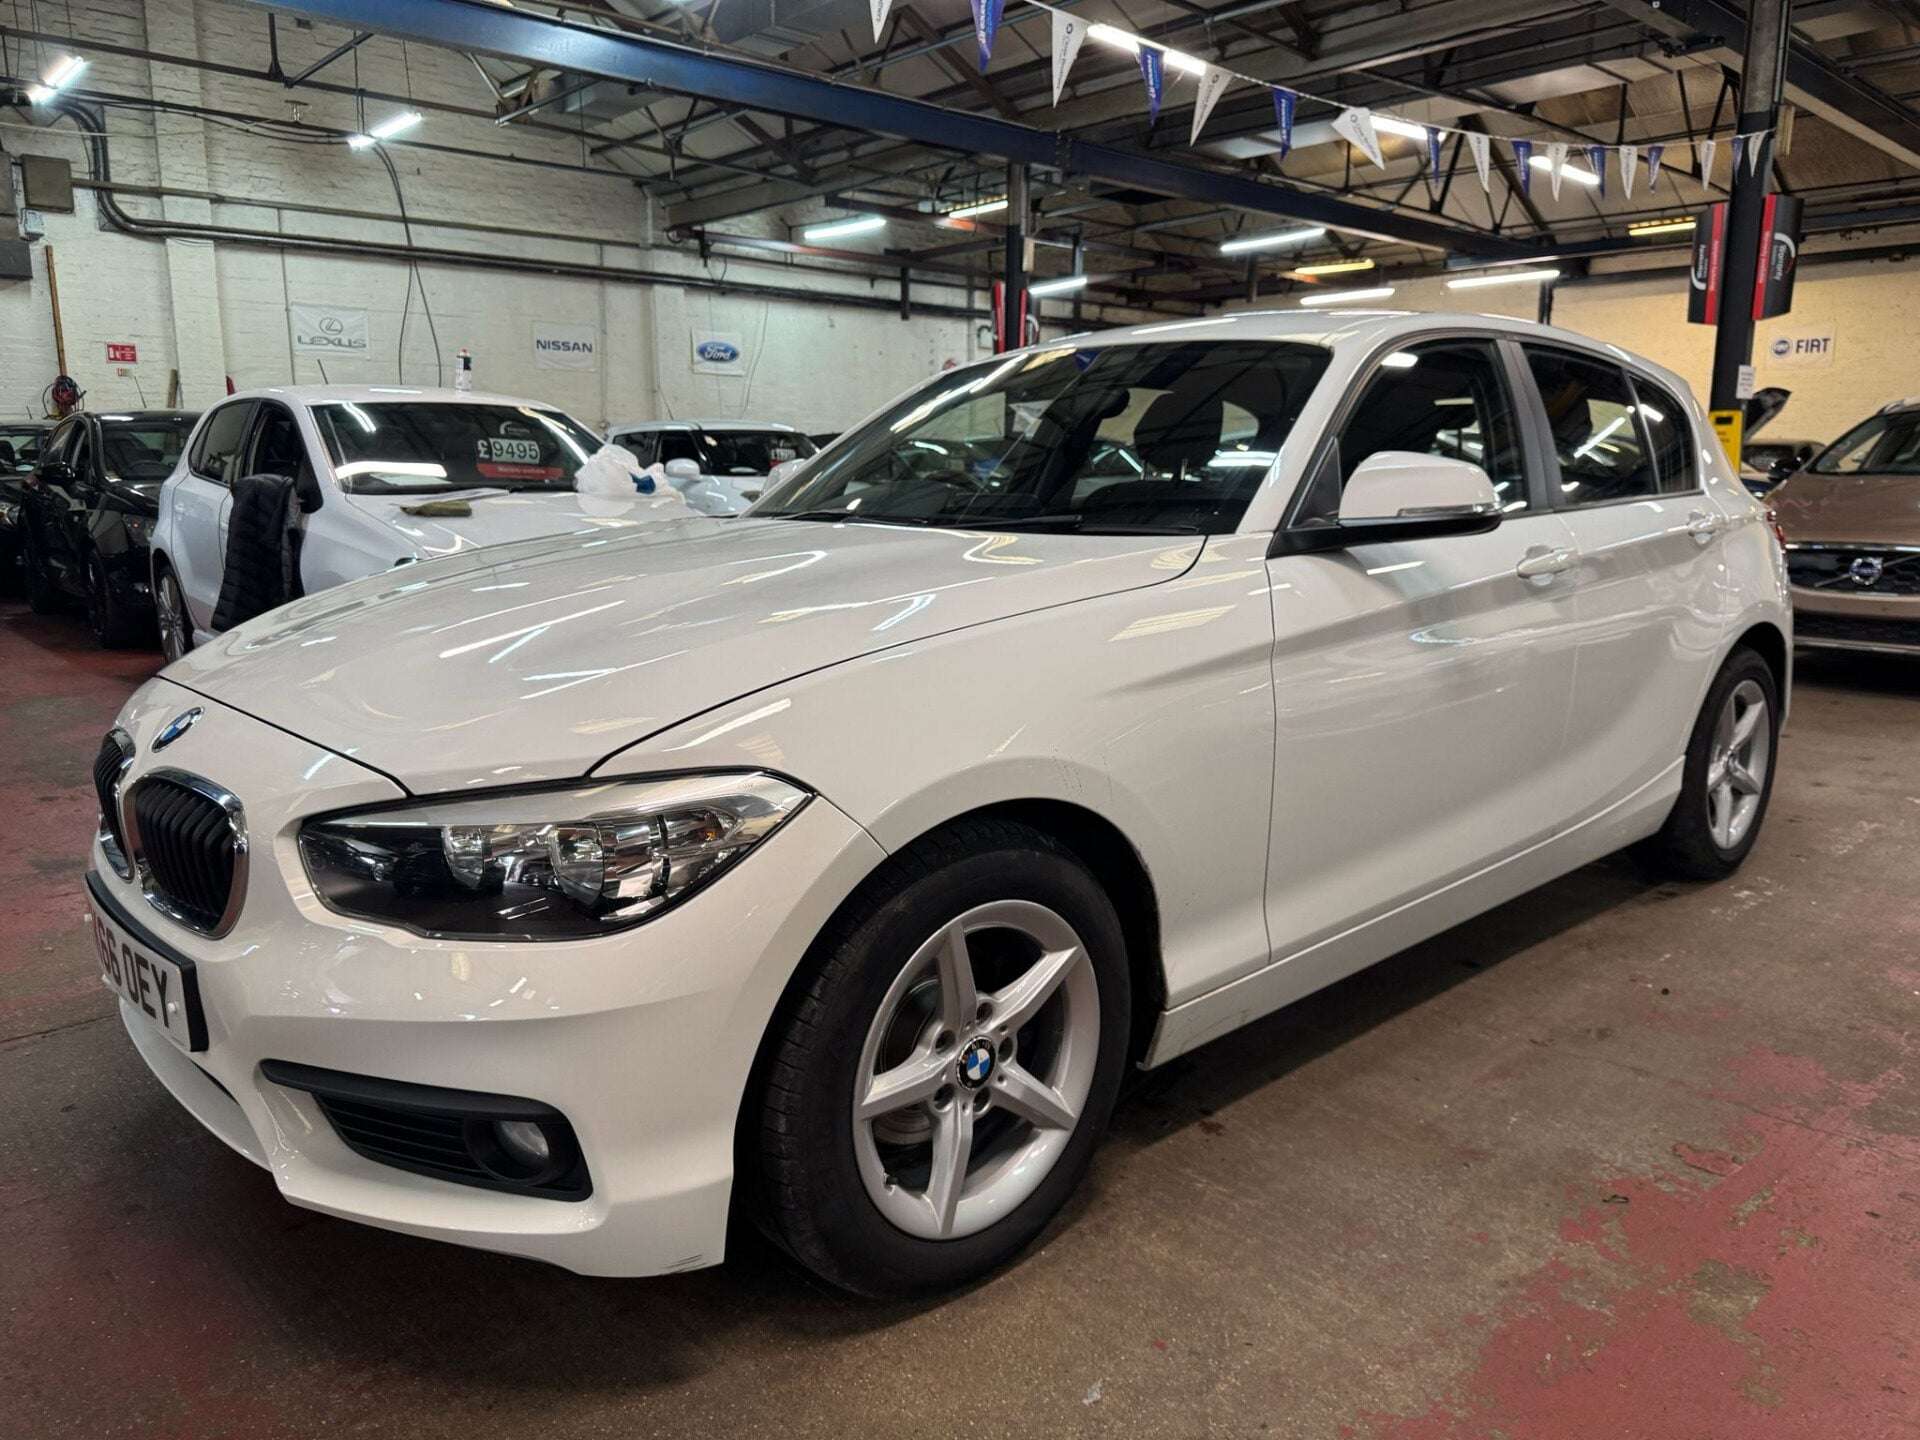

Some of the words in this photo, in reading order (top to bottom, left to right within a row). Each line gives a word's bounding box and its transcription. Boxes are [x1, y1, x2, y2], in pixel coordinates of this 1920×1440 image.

[297, 335, 367, 349] LEXUS
[536, 339, 593, 353] NISSAN
[1795, 337, 1831, 354] FIAT
[477, 440, 539, 461] £9495
[121, 943, 169, 1028] OEY
